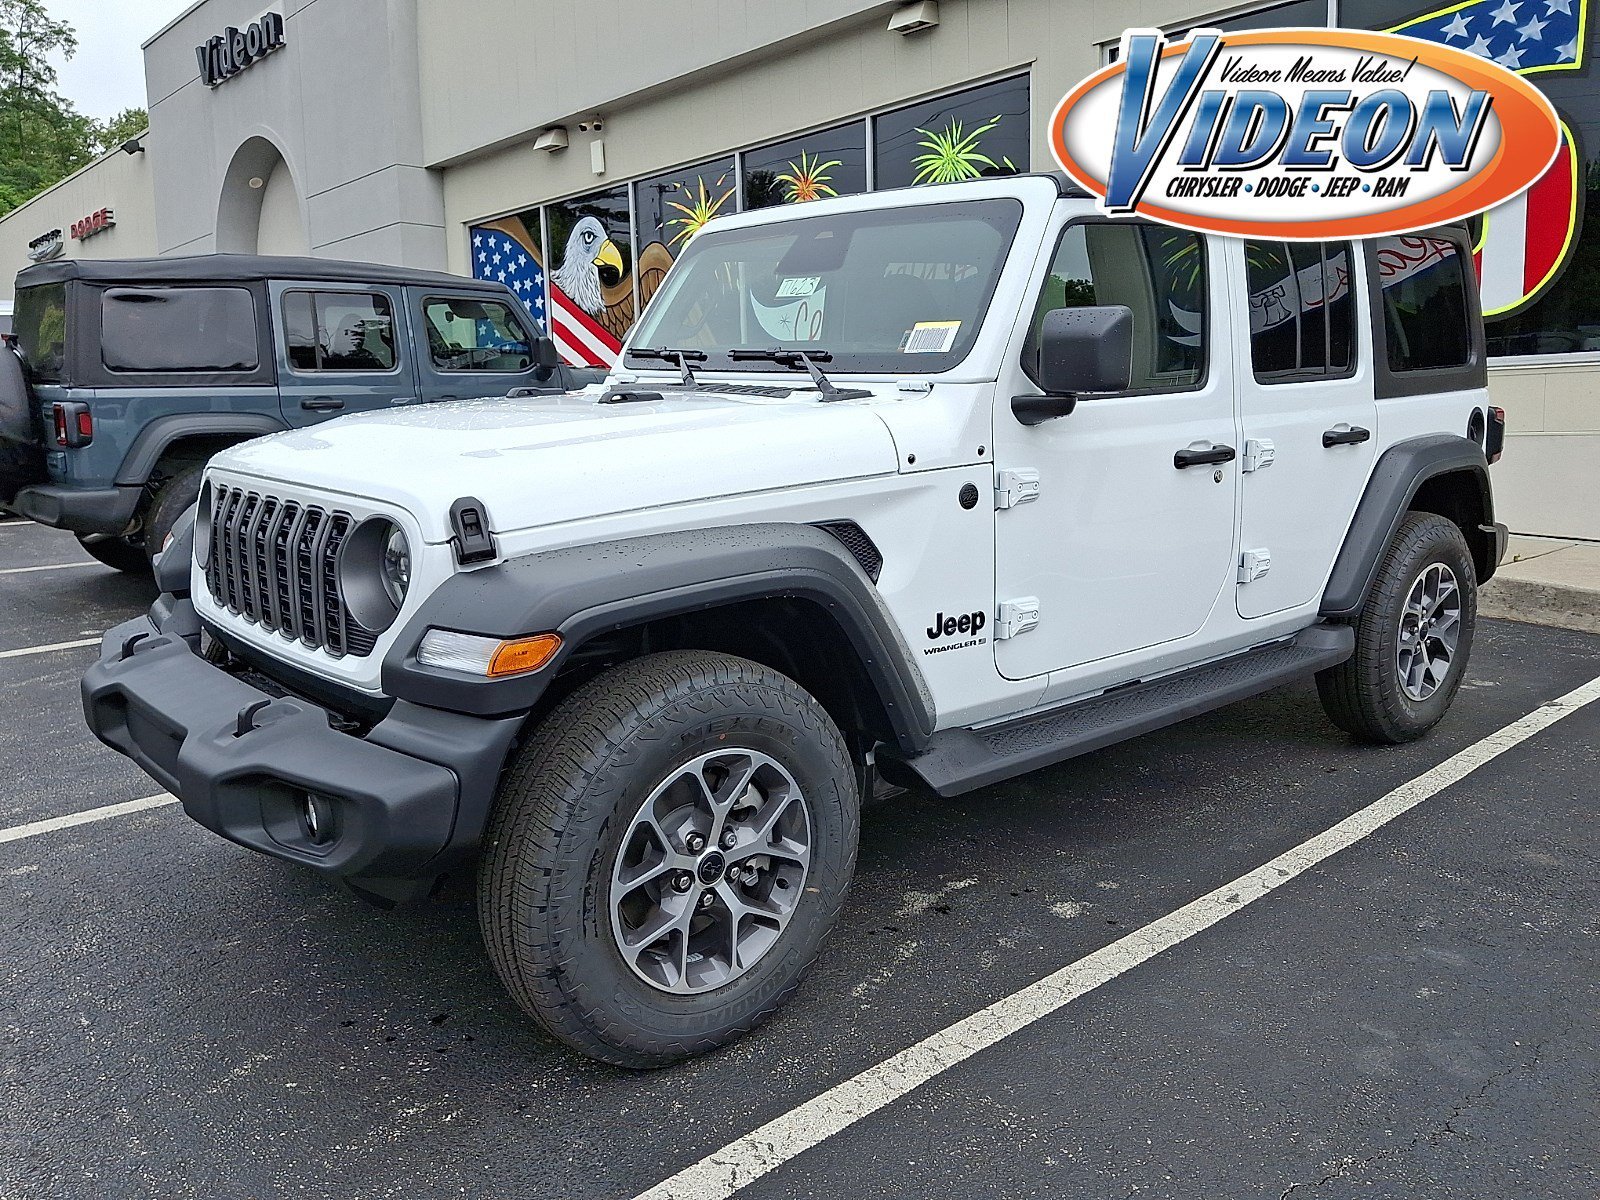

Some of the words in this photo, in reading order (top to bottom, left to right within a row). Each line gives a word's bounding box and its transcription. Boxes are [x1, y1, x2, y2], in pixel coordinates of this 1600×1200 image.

[195, 12, 284, 86] Videon
[70, 207, 114, 240] DODGE
[926, 610, 986, 640] Jeep
[923, 640, 977, 655] WRANGLER
